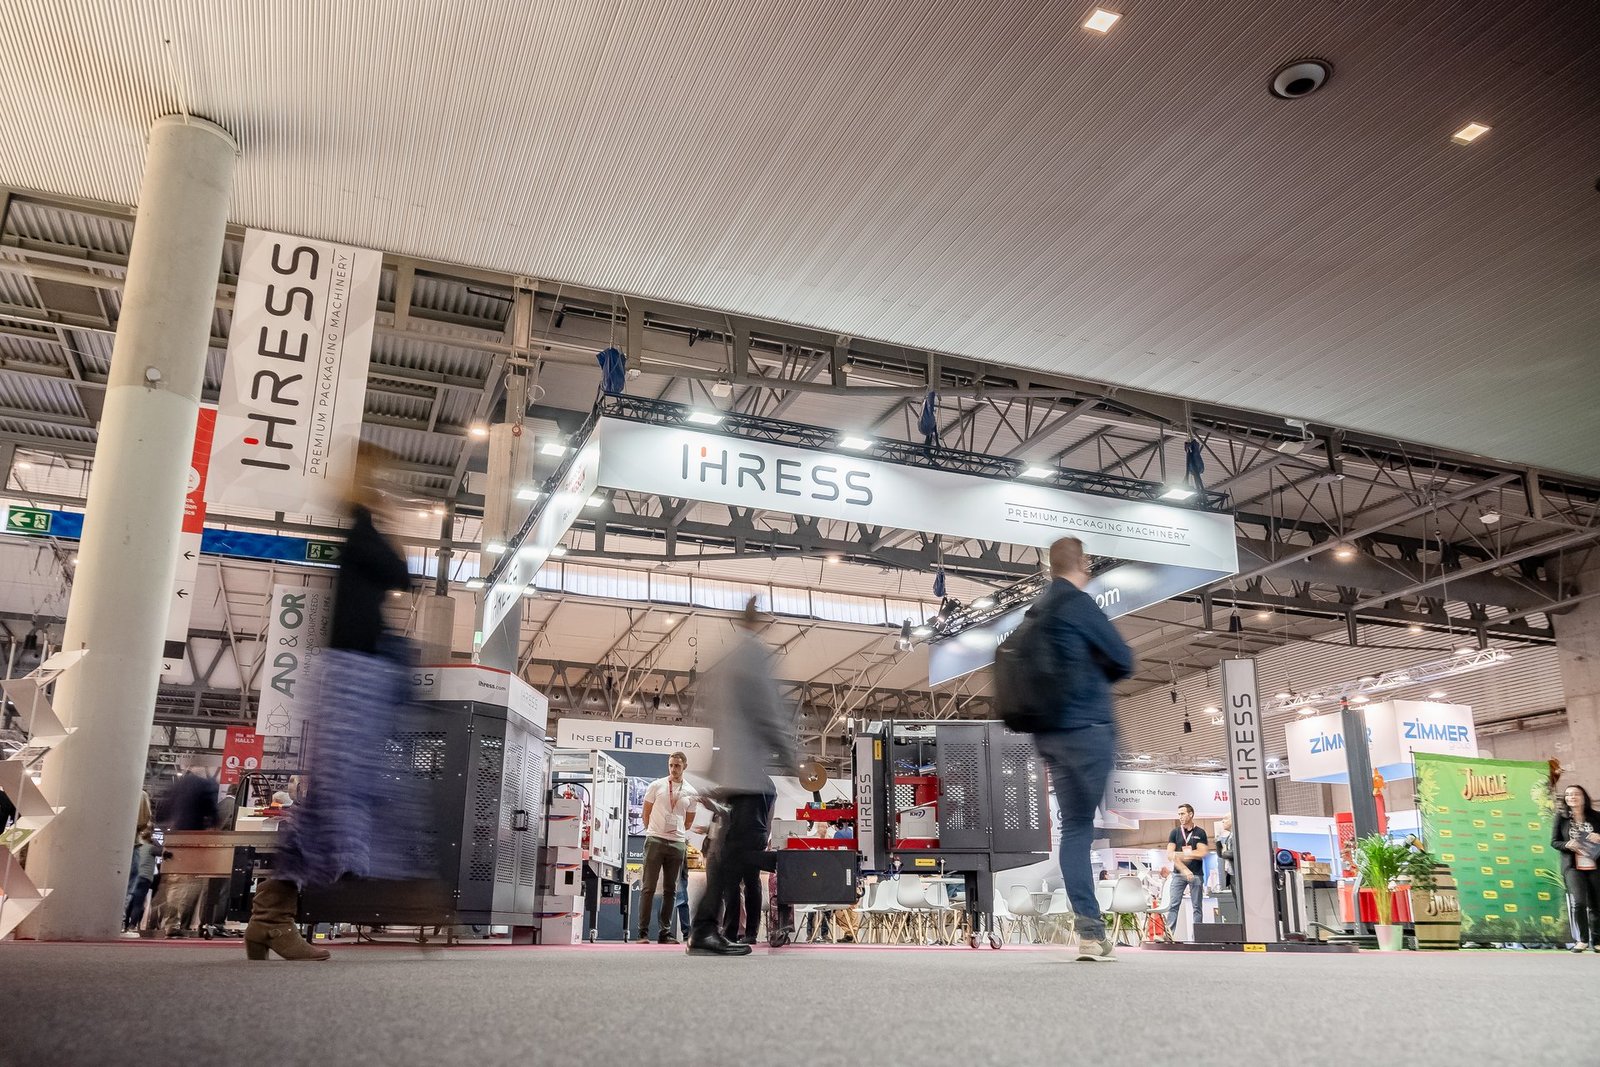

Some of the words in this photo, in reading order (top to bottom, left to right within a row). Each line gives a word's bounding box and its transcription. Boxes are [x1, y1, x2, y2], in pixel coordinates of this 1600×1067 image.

[330, 253, 349, 329] MACHINERY
[241, 242, 320, 471] IHRESS
[318, 333, 339, 407] PACKAGING
[309, 411, 328, 475] PREMIUM
[681, 443, 874, 507] IHRESS
[1007, 507, 1059, 523] PREMIUM
[1062, 515, 1123, 533] PACKAGING
[1126, 525, 1187, 541] MACHINERY
[279, 593, 307, 630] OR
[279, 634, 299, 648] &
[270, 652, 299, 700] AND
[571, 732, 612, 744] INSER
[634, 737, 701, 749] ROBÓTICA
[1232, 693, 1259, 789] IHRESS
[860, 773, 873, 833] IHRESS
[1146, 788, 1157, 796] the
[1213, 790, 1229, 802] AB
[1240, 798, 1261, 806] i200
